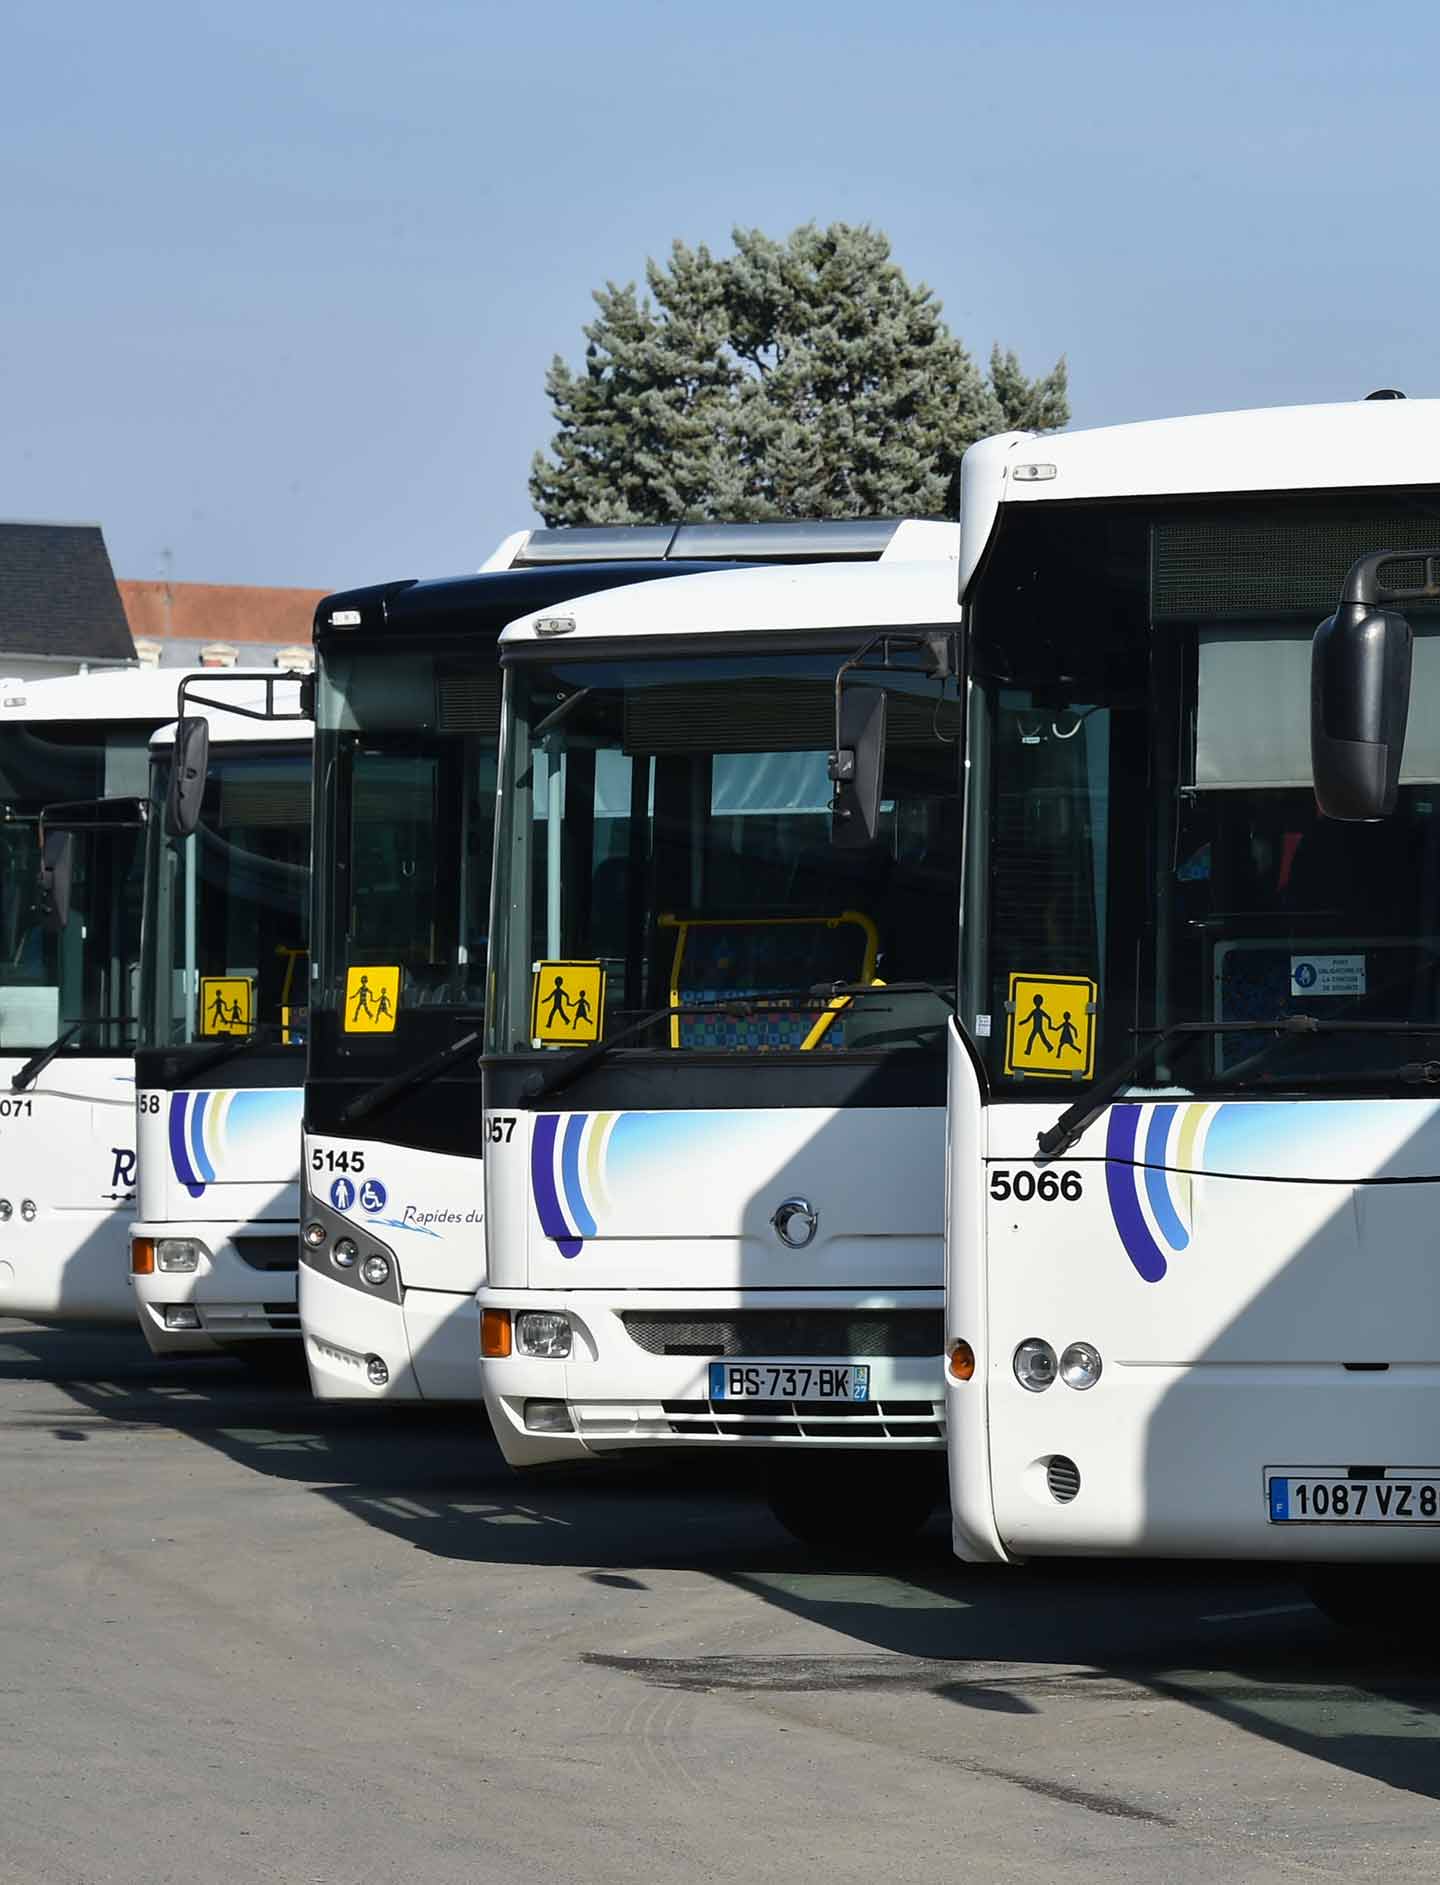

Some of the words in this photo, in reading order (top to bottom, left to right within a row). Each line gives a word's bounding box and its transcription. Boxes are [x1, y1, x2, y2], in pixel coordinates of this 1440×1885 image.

[312, 1149, 365, 1172] 5145
[990, 1170, 1083, 1202] 5066
[403, 1205, 462, 1225] Rapides
[465, 1209, 483, 1223] du
[854, 1386, 866, 1399] 27
